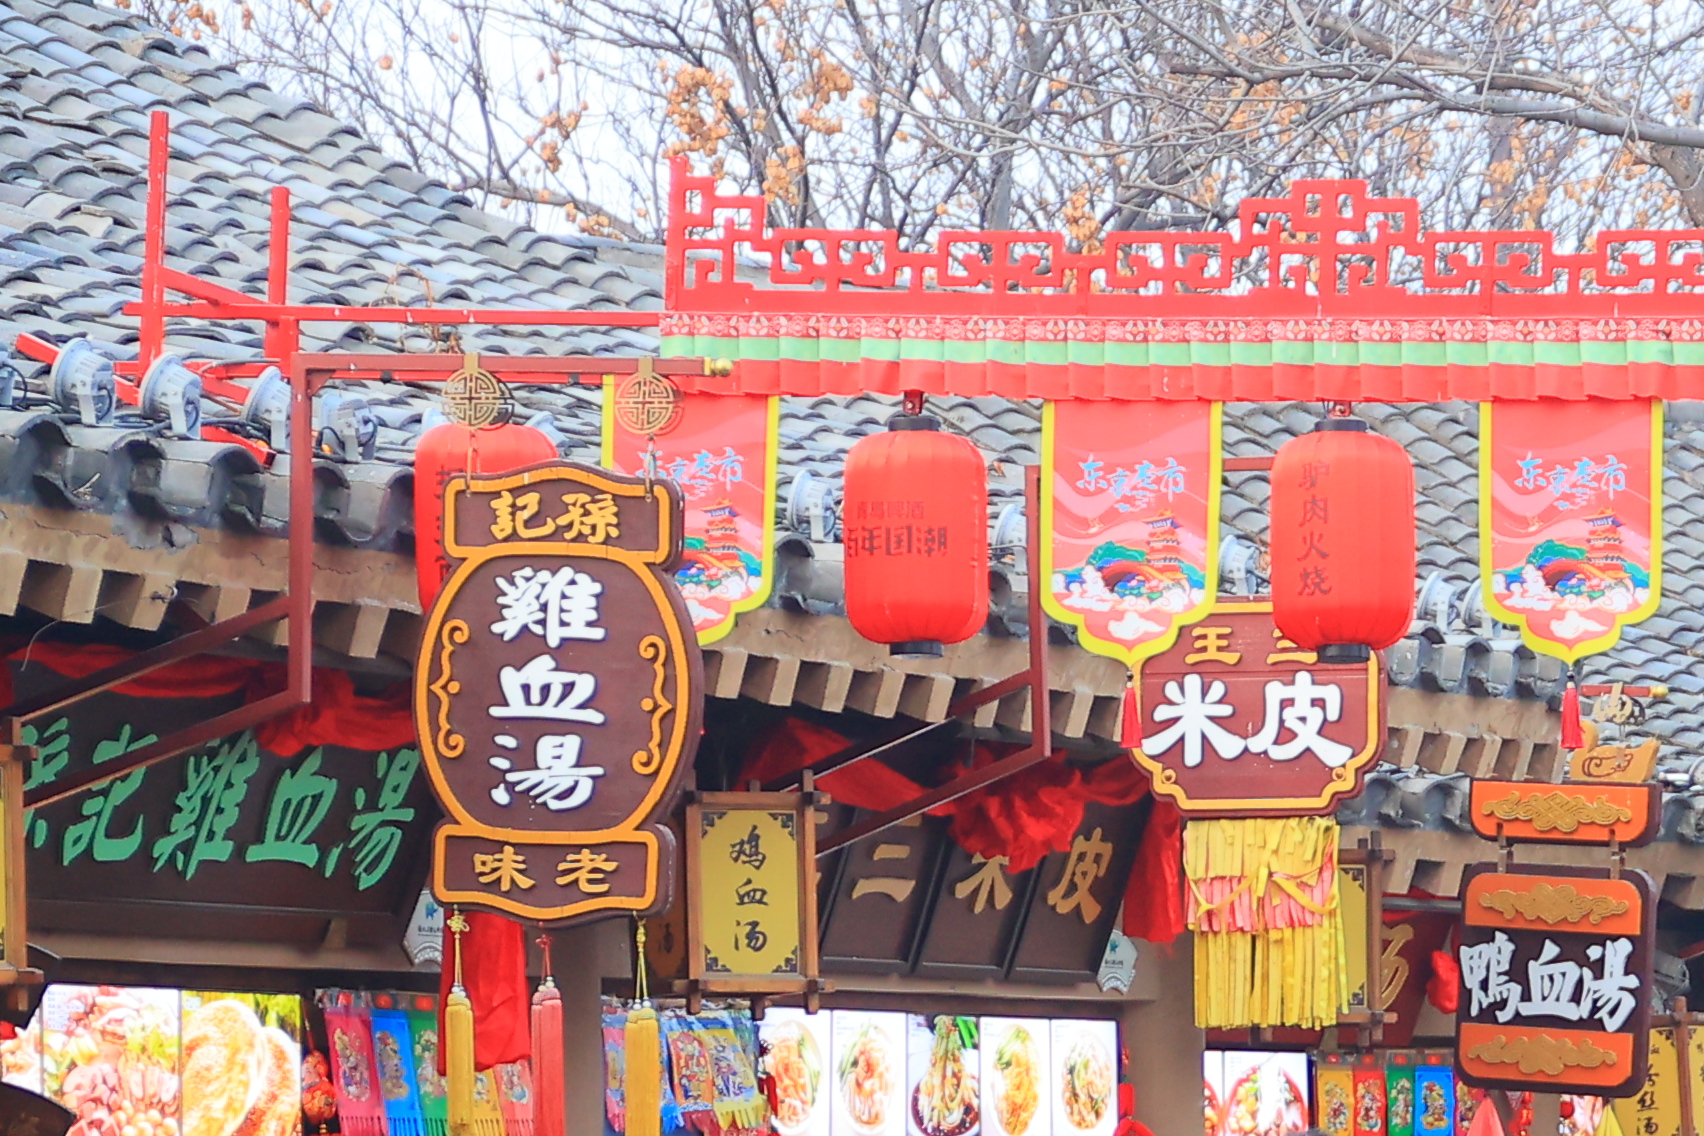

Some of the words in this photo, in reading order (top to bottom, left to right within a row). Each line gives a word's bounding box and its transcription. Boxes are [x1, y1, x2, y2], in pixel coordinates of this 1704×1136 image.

[1299, 460, 1332, 597] 驴肉火烧
[489, 565, 606, 811] 雞血湯
[1141, 672, 1354, 767] 米皮
[729, 832, 768, 954] 鸡血汤
[1459, 930, 1640, 1033] 鴨血湯
